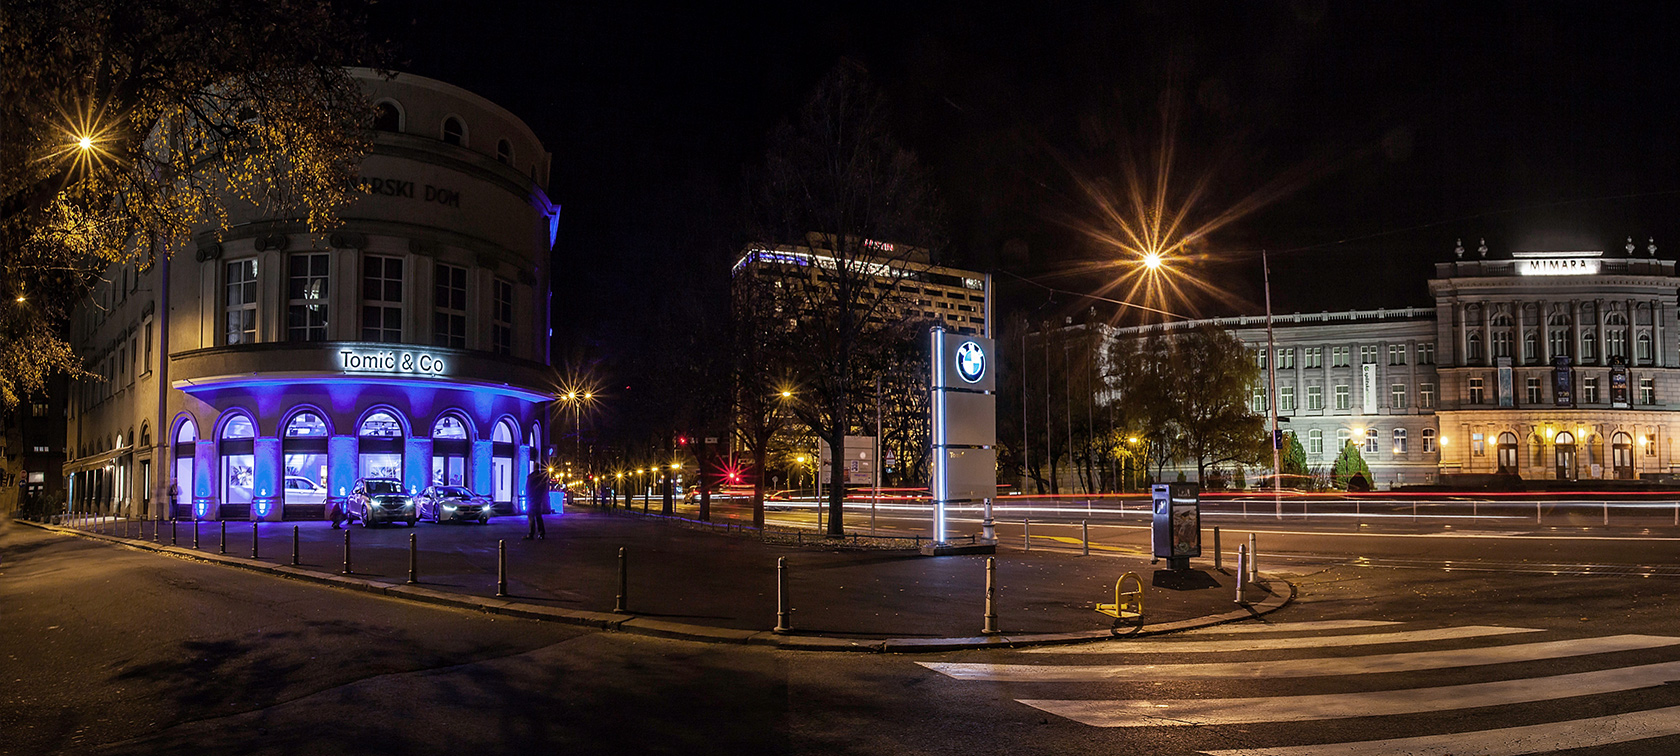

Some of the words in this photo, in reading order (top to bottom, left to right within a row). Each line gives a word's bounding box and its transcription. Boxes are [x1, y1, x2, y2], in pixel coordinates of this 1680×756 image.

[425, 184, 460, 208] DOM
[1530, 259, 1587, 270] MIMARA
[958, 342, 985, 359] BMW
[340, 351, 395, 369] Tomić
[402, 354, 414, 371] &
[420, 355, 444, 372] Co
